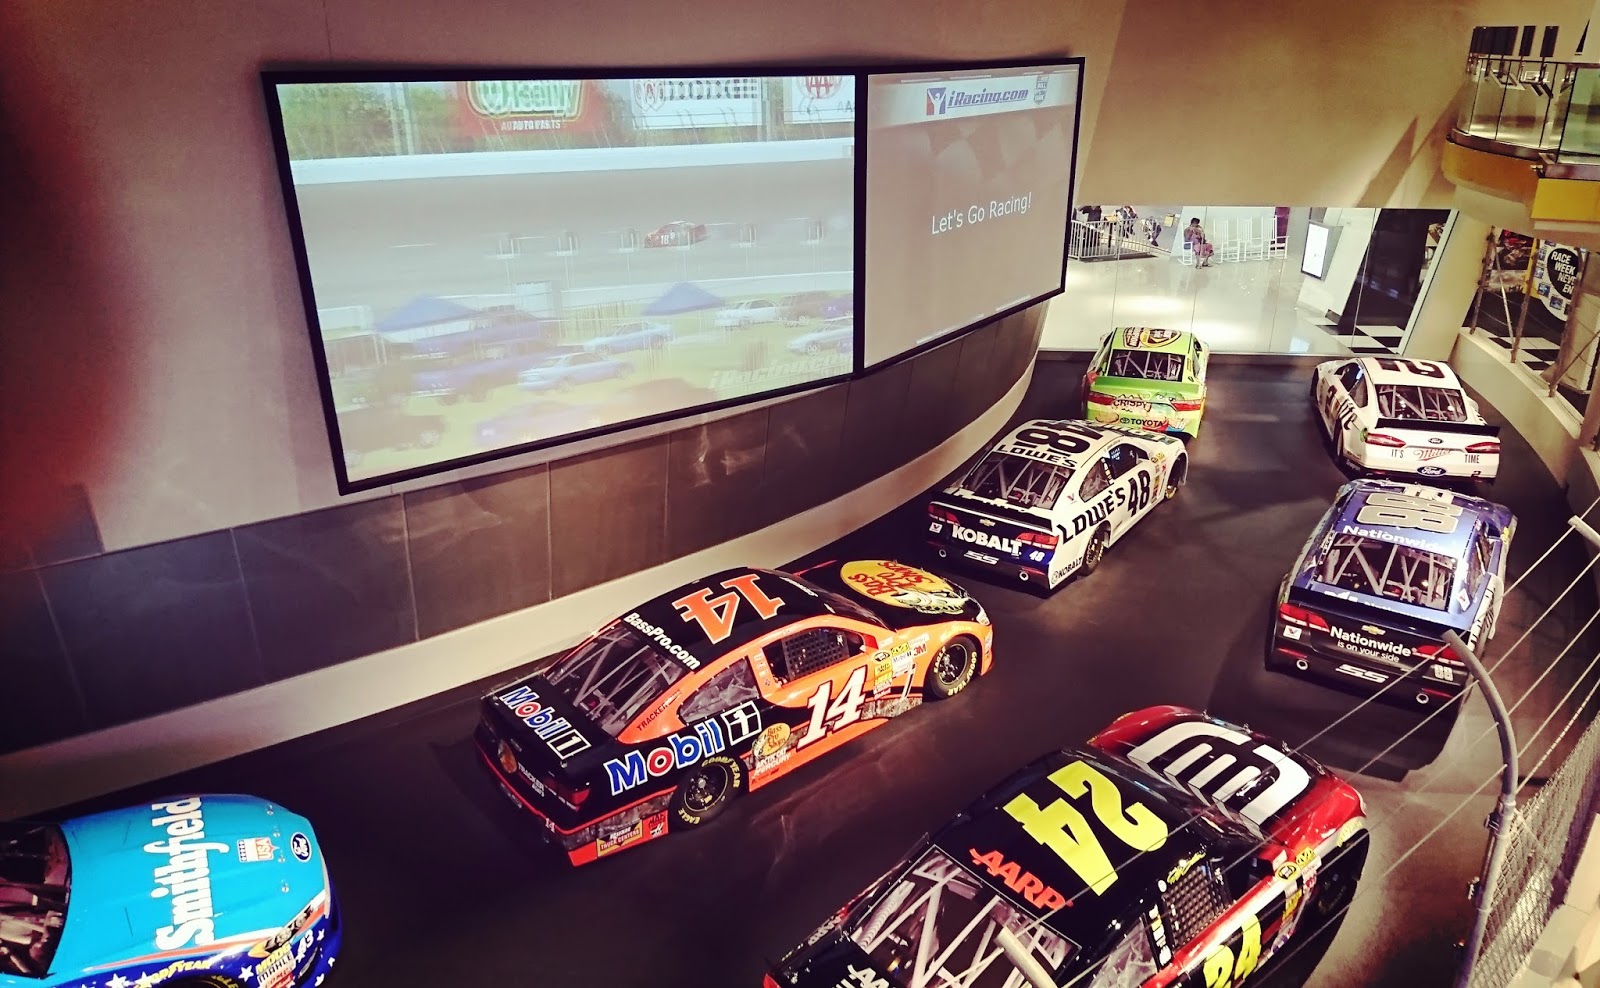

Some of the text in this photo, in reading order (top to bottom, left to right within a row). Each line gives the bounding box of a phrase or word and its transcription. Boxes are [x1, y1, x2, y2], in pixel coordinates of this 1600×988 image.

[947, 88, 1029, 108] iRacing.com
[931, 191, 1033, 235] Let's Go Racing!
[1550, 250, 1572, 265] RACE
[1554, 261, 1577, 276] WEEK
[1131, 419, 1163, 427] TOYOTA
[999, 443, 1078, 469] LOWE'S
[1391, 449, 1404, 459] IT'S
[1464, 454, 1480, 464] TIME
[1127, 469, 1151, 518] 48
[1056, 486, 1126, 544] LOWE'S
[1356, 492, 1464, 535] 88
[963, 550, 999, 565] SS
[1029, 550, 1046, 562] 48
[673, 573, 786, 646] 14
[623, 612, 702, 671] BassPro.com
[914, 643, 927, 657] 3M
[1329, 625, 1412, 658] Nationwide
[1337, 640, 1400, 663] is on your side
[1335, 663, 1389, 684] SS
[1433, 664, 1454, 681] 88
[499, 685, 572, 741] Mobil
[636, 702, 668, 733] TRACKER
[797, 667, 867, 751] 14
[603, 717, 726, 797] Mobil
[544, 817, 556, 834] 14
[1001, 760, 1170, 897] 24
[143, 796, 231, 951] Smithfield
[968, 847, 1069, 912] AARP
